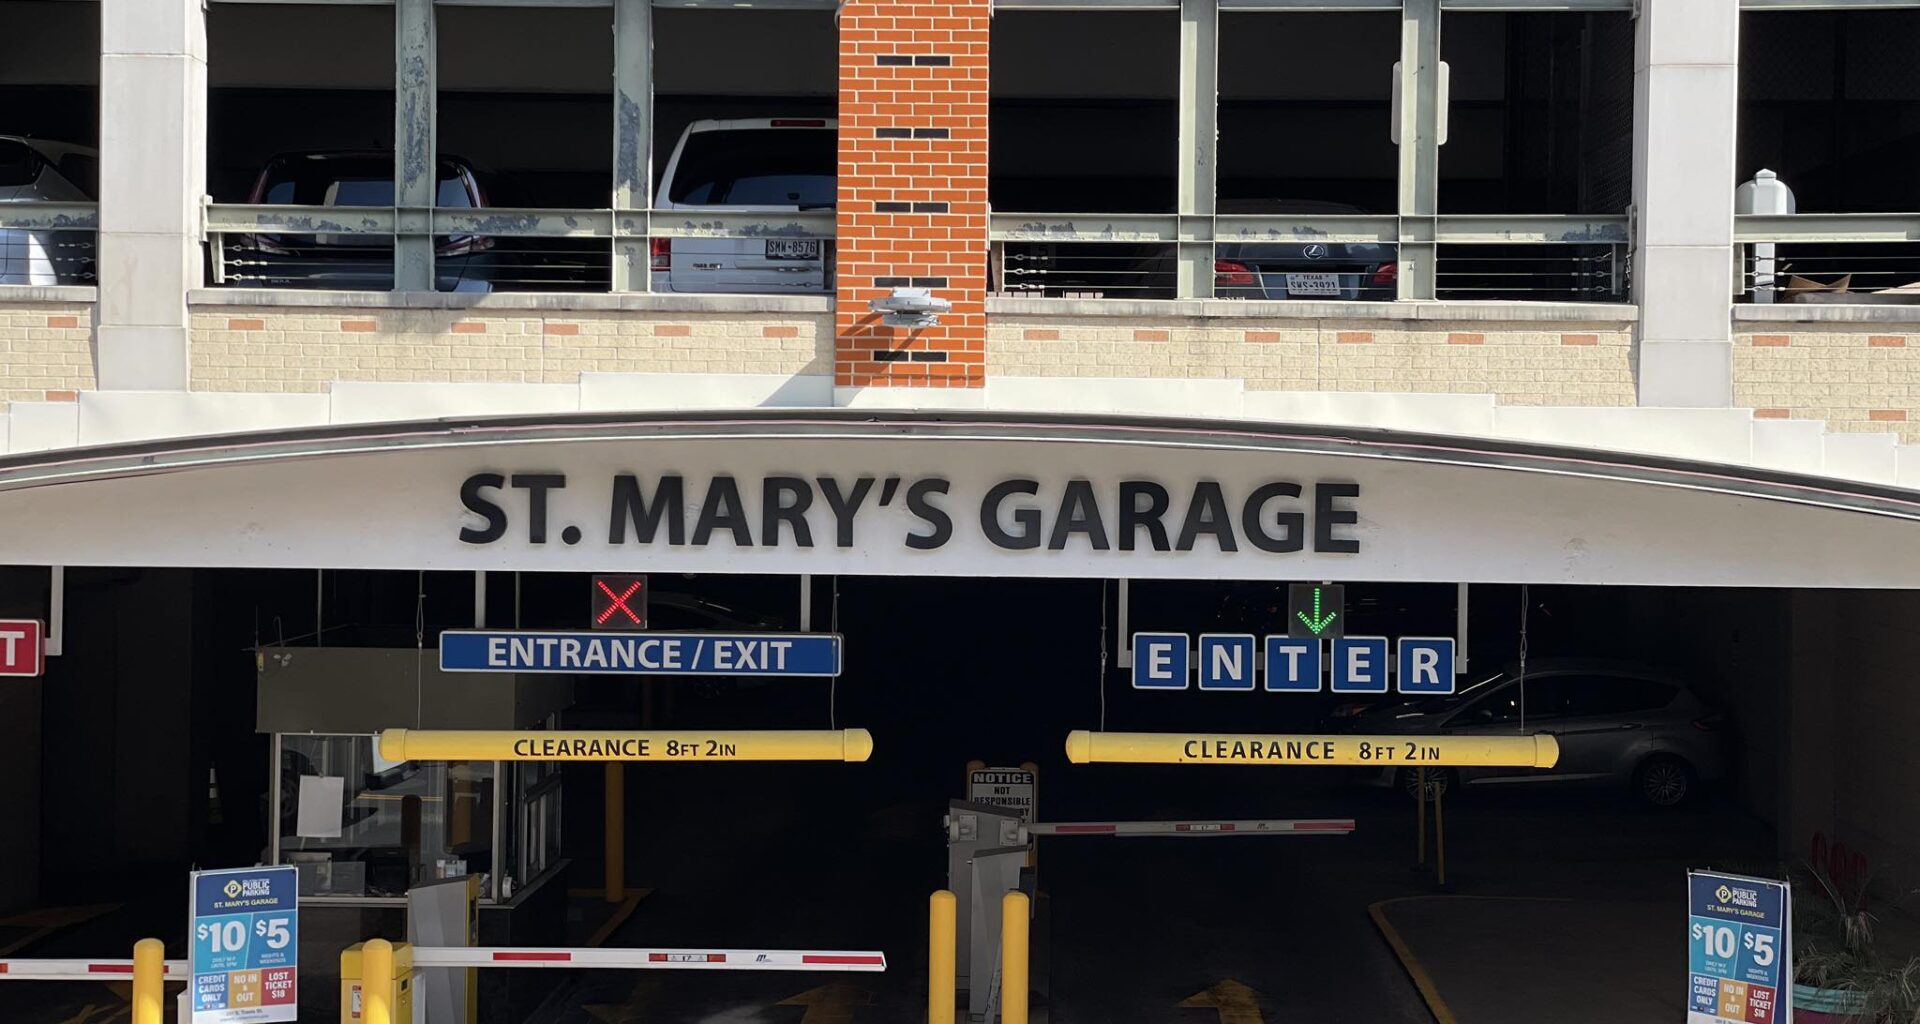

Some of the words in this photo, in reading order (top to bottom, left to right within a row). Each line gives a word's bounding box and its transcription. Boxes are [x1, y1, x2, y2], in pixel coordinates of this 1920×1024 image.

[459, 473, 582, 545] ST.
[609, 475, 953, 550] MARY'S
[980, 479, 1360, 553] GARAGE
[488, 637, 682, 669] ENTRANCE
[714, 640, 792, 671] EXIT
[514, 738, 650, 757] CLEARANCE
[666, 739, 699, 757] 8FT
[705, 739, 736, 757] 2IN
[1184, 740, 1335, 761] CLEARANCE
[1359, 742, 1395, 761] 8FT
[1404, 742, 1440, 761] 2IN
[973, 773, 1032, 784] NOTICE
[994, 786, 1010, 795] NOT
[974, 796, 1031, 806] RESPONSIBLE
[242, 881, 270, 890] PUBLIC
[242, 888, 270, 897] PARKING
[1732, 890, 1757, 901] PUBLIC
[225, 900, 250, 908] MARY'S
[251, 898, 278, 906] GARAGE
[1732, 897, 1757, 908] PARKING
[1716, 906, 1739, 915] MARY'S
[1740, 909, 1765, 919] GARAGE
[197, 920, 246, 953] $10
[255, 918, 290, 949] $5
[1692, 922, 1735, 959] $10
[1743, 931, 1774, 966] $5
[198, 974, 226, 985] CREDIT
[233, 974, 247, 984] NO
[248, 973, 257, 983] IN
[269, 971, 289, 981] LOST
[264, 980, 292, 991] TICKET
[1693, 976, 1718, 988] CREDIT
[198, 983, 225, 993] CARDS
[1694, 985, 1716, 997] CARDS
[1723, 984, 1734, 994] NO
[1735, 986, 1744, 995] IN
[201, 993, 222, 1003] ONLY
[236, 992, 255, 1003] OUT
[1696, 994, 1713, 1006] ONLY
[1753, 989, 1770, 1000] LOST
[1725, 1003, 1740, 1014] OUT
[1749, 998, 1772, 1010] TICKET
